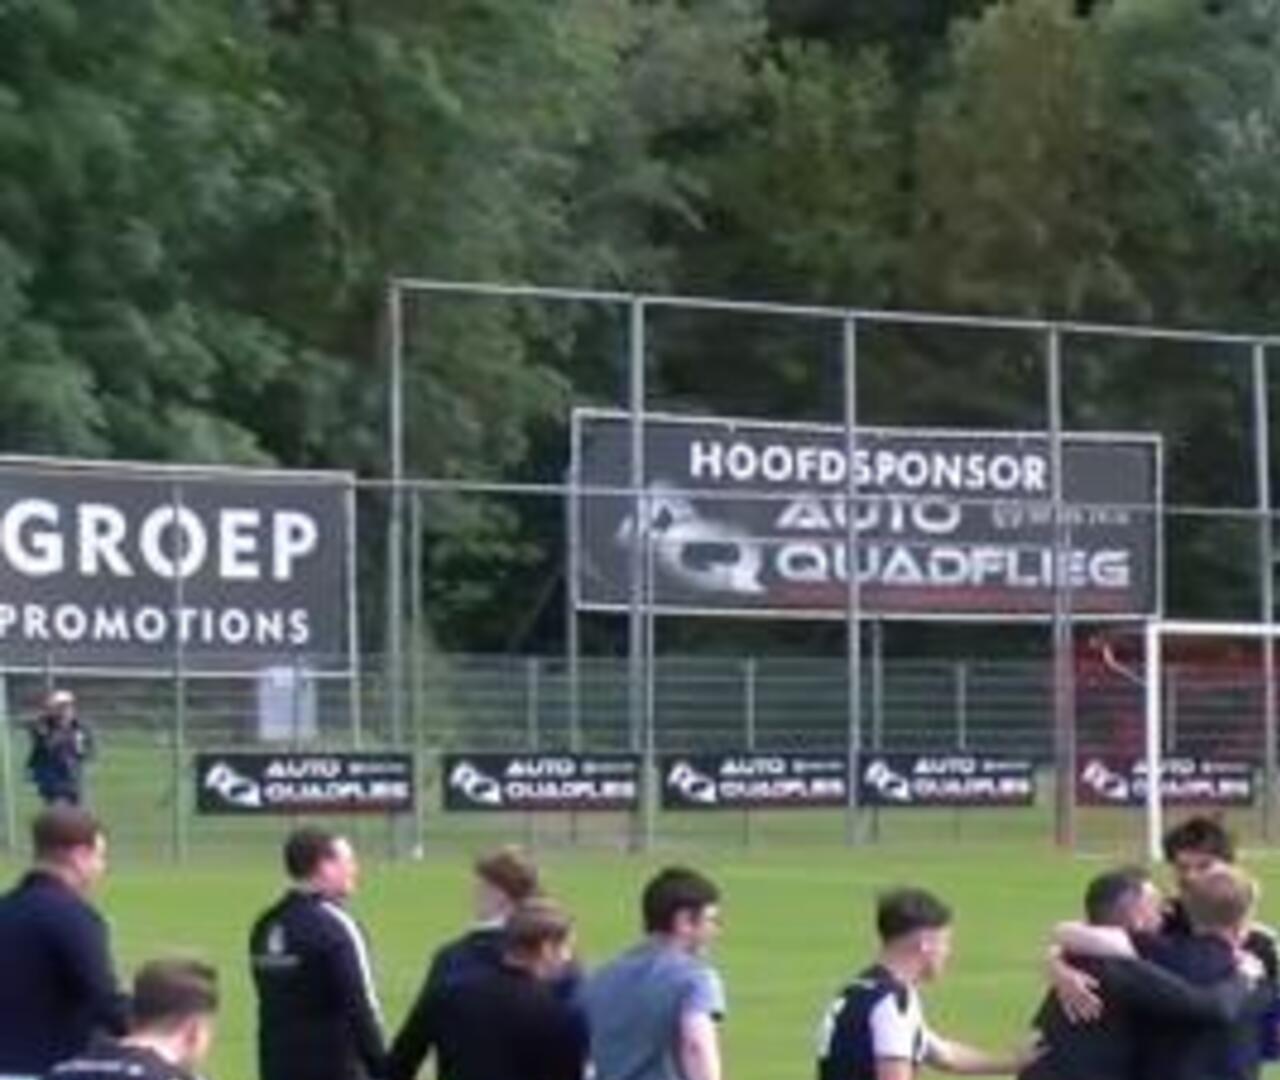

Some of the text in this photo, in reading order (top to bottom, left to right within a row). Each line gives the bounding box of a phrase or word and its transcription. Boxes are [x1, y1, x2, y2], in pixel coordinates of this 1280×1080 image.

[690, 442, 1048, 491] HOOFDSPONSOR
[775, 493, 962, 533] AUTO
[0, 497, 319, 581] GROEP
[775, 543, 1132, 588] QUADFLIEG
[0, 602, 311, 644] PROMOTIONS
[265, 759, 341, 778] AUTO
[505, 759, 575, 777] AUTO
